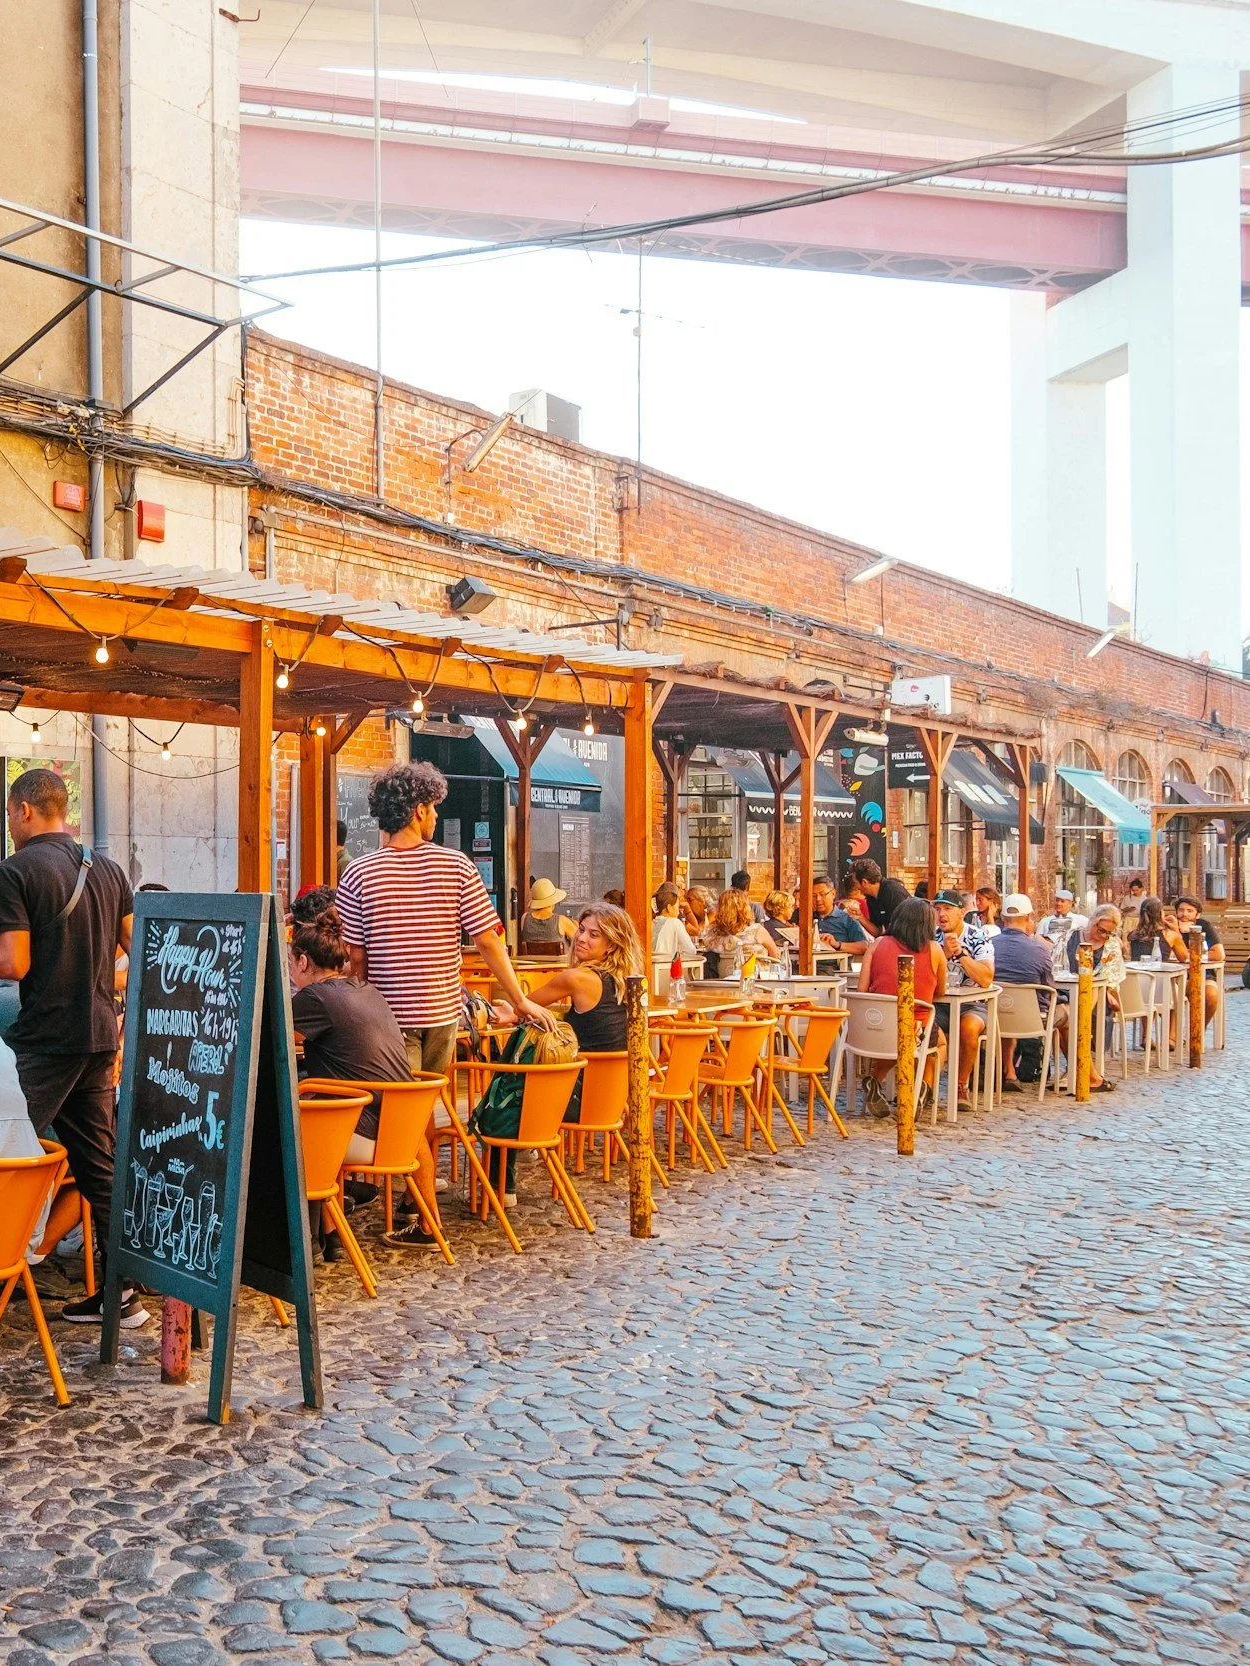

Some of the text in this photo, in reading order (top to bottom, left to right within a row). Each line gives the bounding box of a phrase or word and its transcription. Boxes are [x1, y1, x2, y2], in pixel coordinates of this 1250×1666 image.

[578, 739, 608, 761] AVENIDA
[157, 925, 227, 994] Happy Hour
[146, 1008, 199, 1038] MARGARITAS
[147, 1056, 200, 1105] Mojitos
[139, 1112, 202, 1154] Caipirinhas
